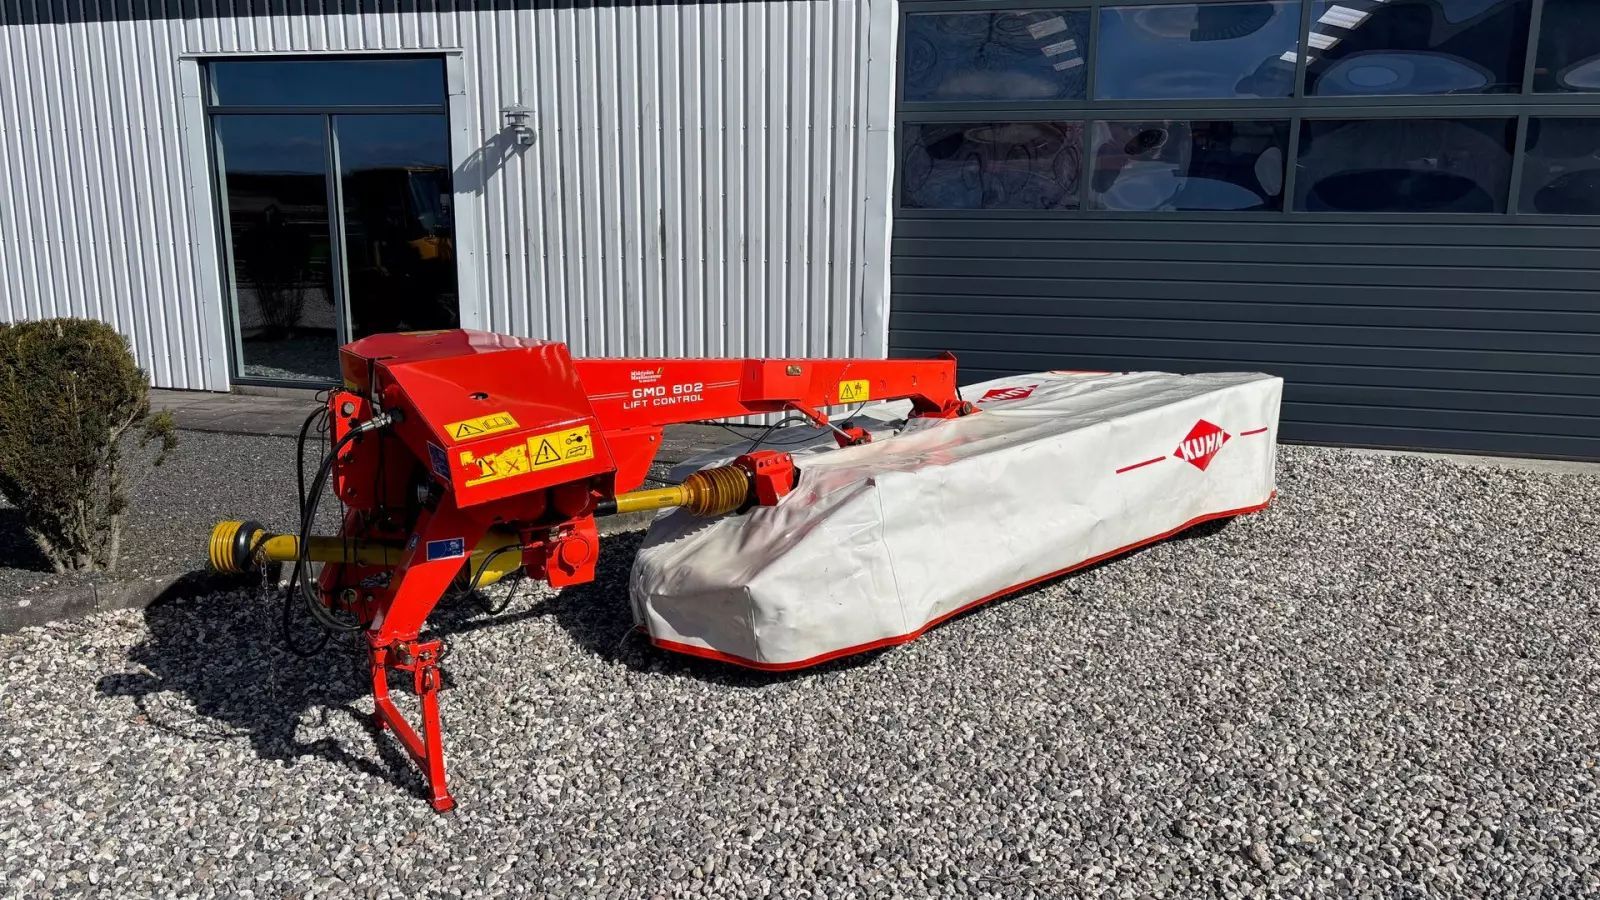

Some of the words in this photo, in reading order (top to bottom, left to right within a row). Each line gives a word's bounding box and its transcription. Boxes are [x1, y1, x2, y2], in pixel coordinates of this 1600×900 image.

[632, 386, 666, 398] GMD
[672, 382, 703, 394] 802
[623, 400, 648, 409] LIFT
[653, 394, 704, 406] CONTROL
[1179, 430, 1224, 462] KUHN
